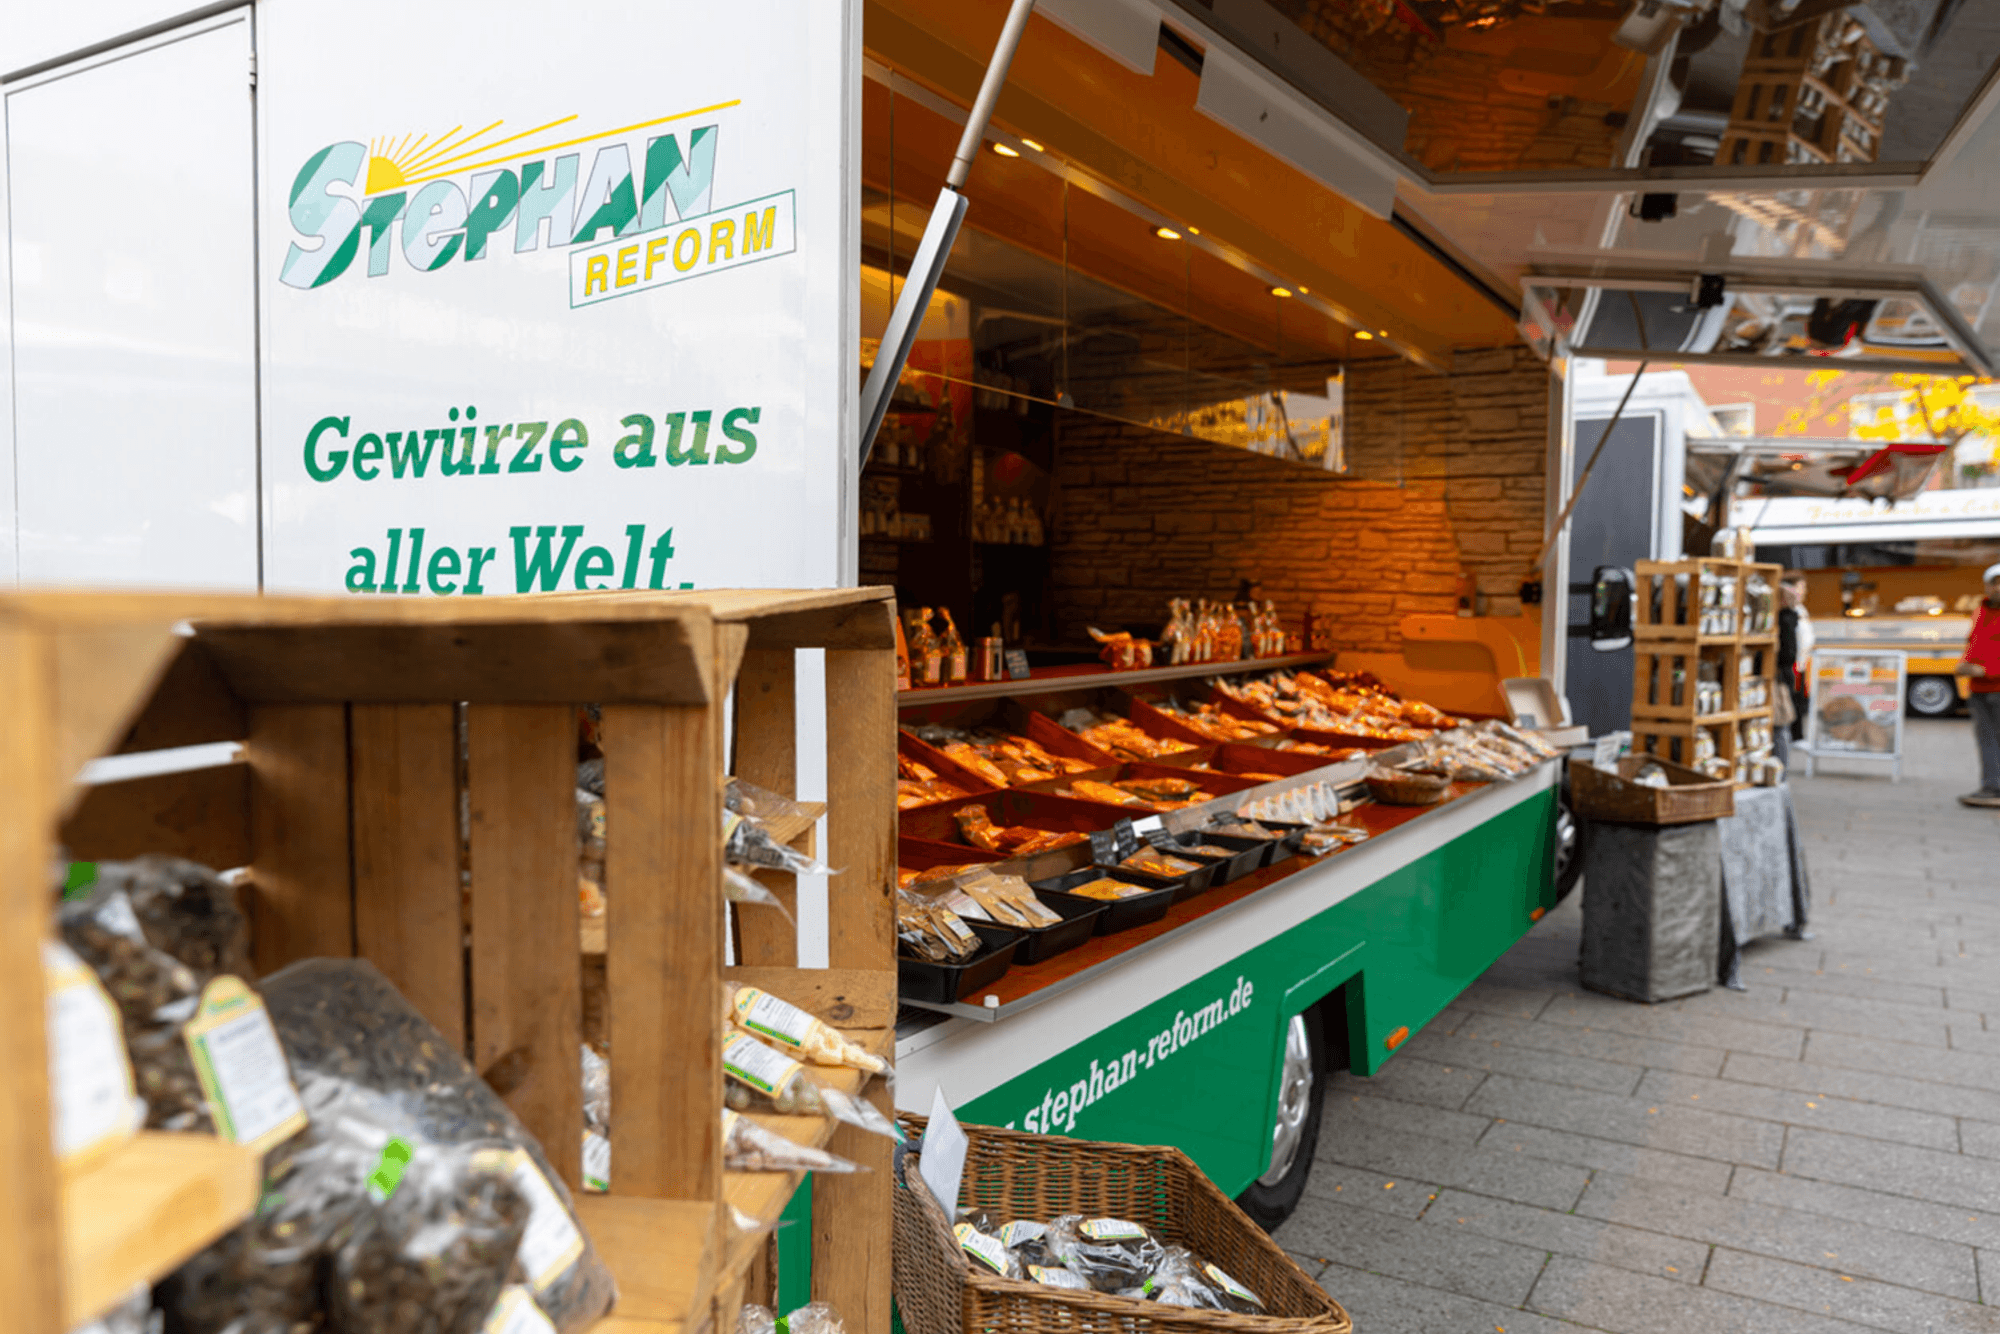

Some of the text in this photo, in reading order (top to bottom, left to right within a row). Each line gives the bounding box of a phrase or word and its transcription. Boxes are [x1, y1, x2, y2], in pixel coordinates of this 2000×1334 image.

[584, 206, 776, 297] REFORM
[303, 404, 762, 483] Gewürze aus
[344, 527, 497, 596] aller
